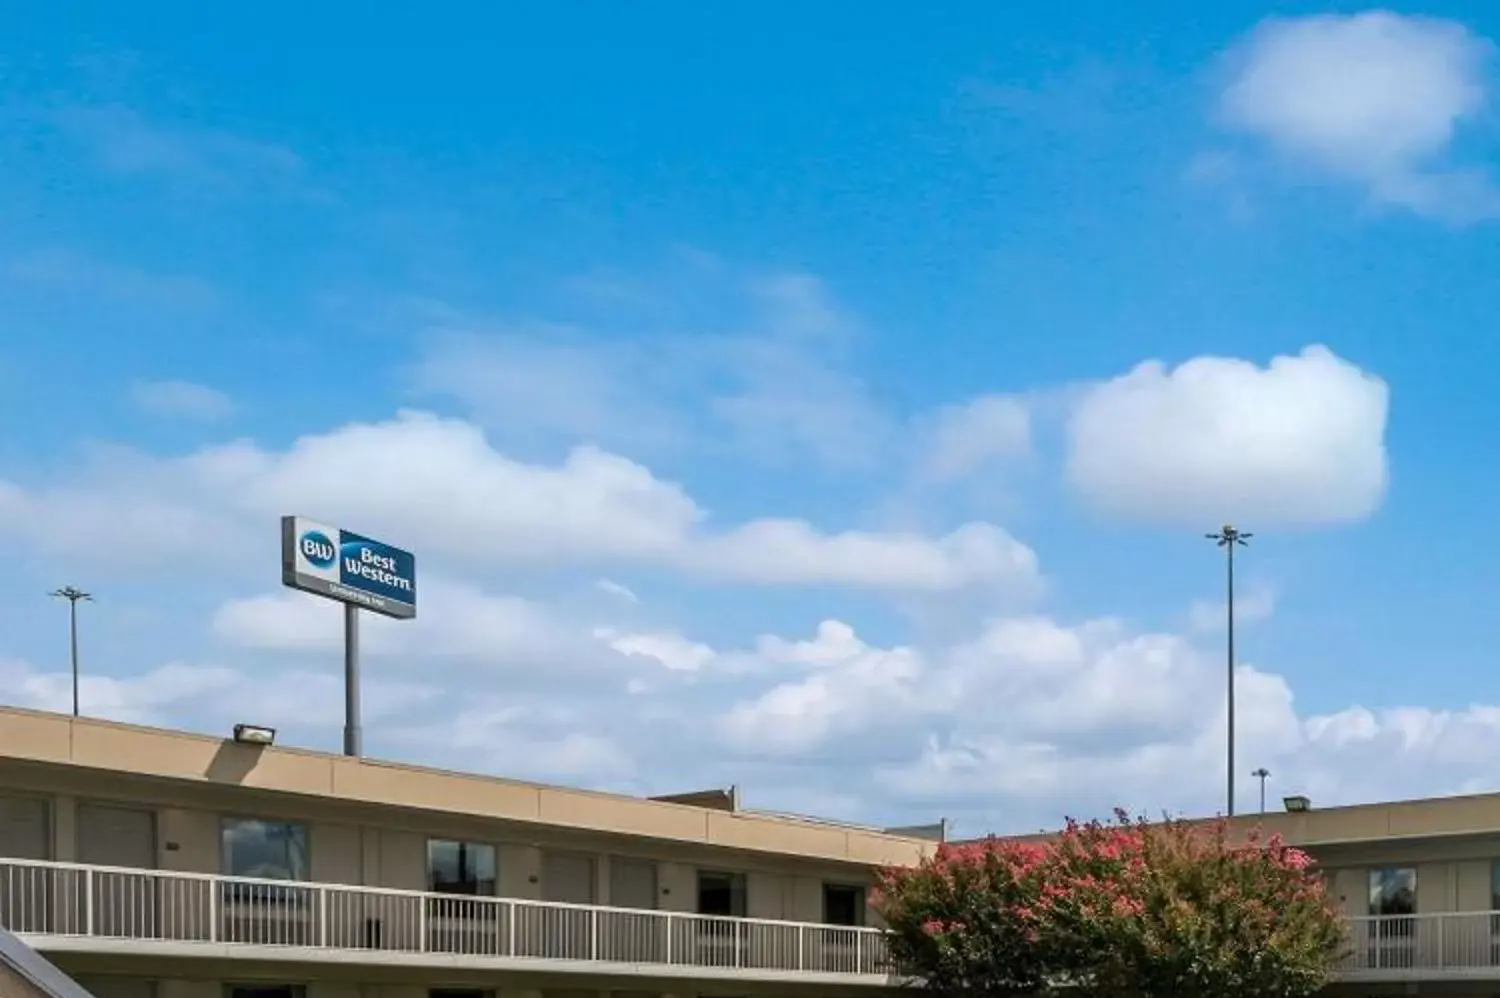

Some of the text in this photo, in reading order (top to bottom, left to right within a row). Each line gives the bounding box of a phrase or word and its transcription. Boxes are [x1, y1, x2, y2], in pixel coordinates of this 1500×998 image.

[303, 539, 333, 560] BW
[361, 547, 396, 573] Best
[345, 556, 410, 590] Western
